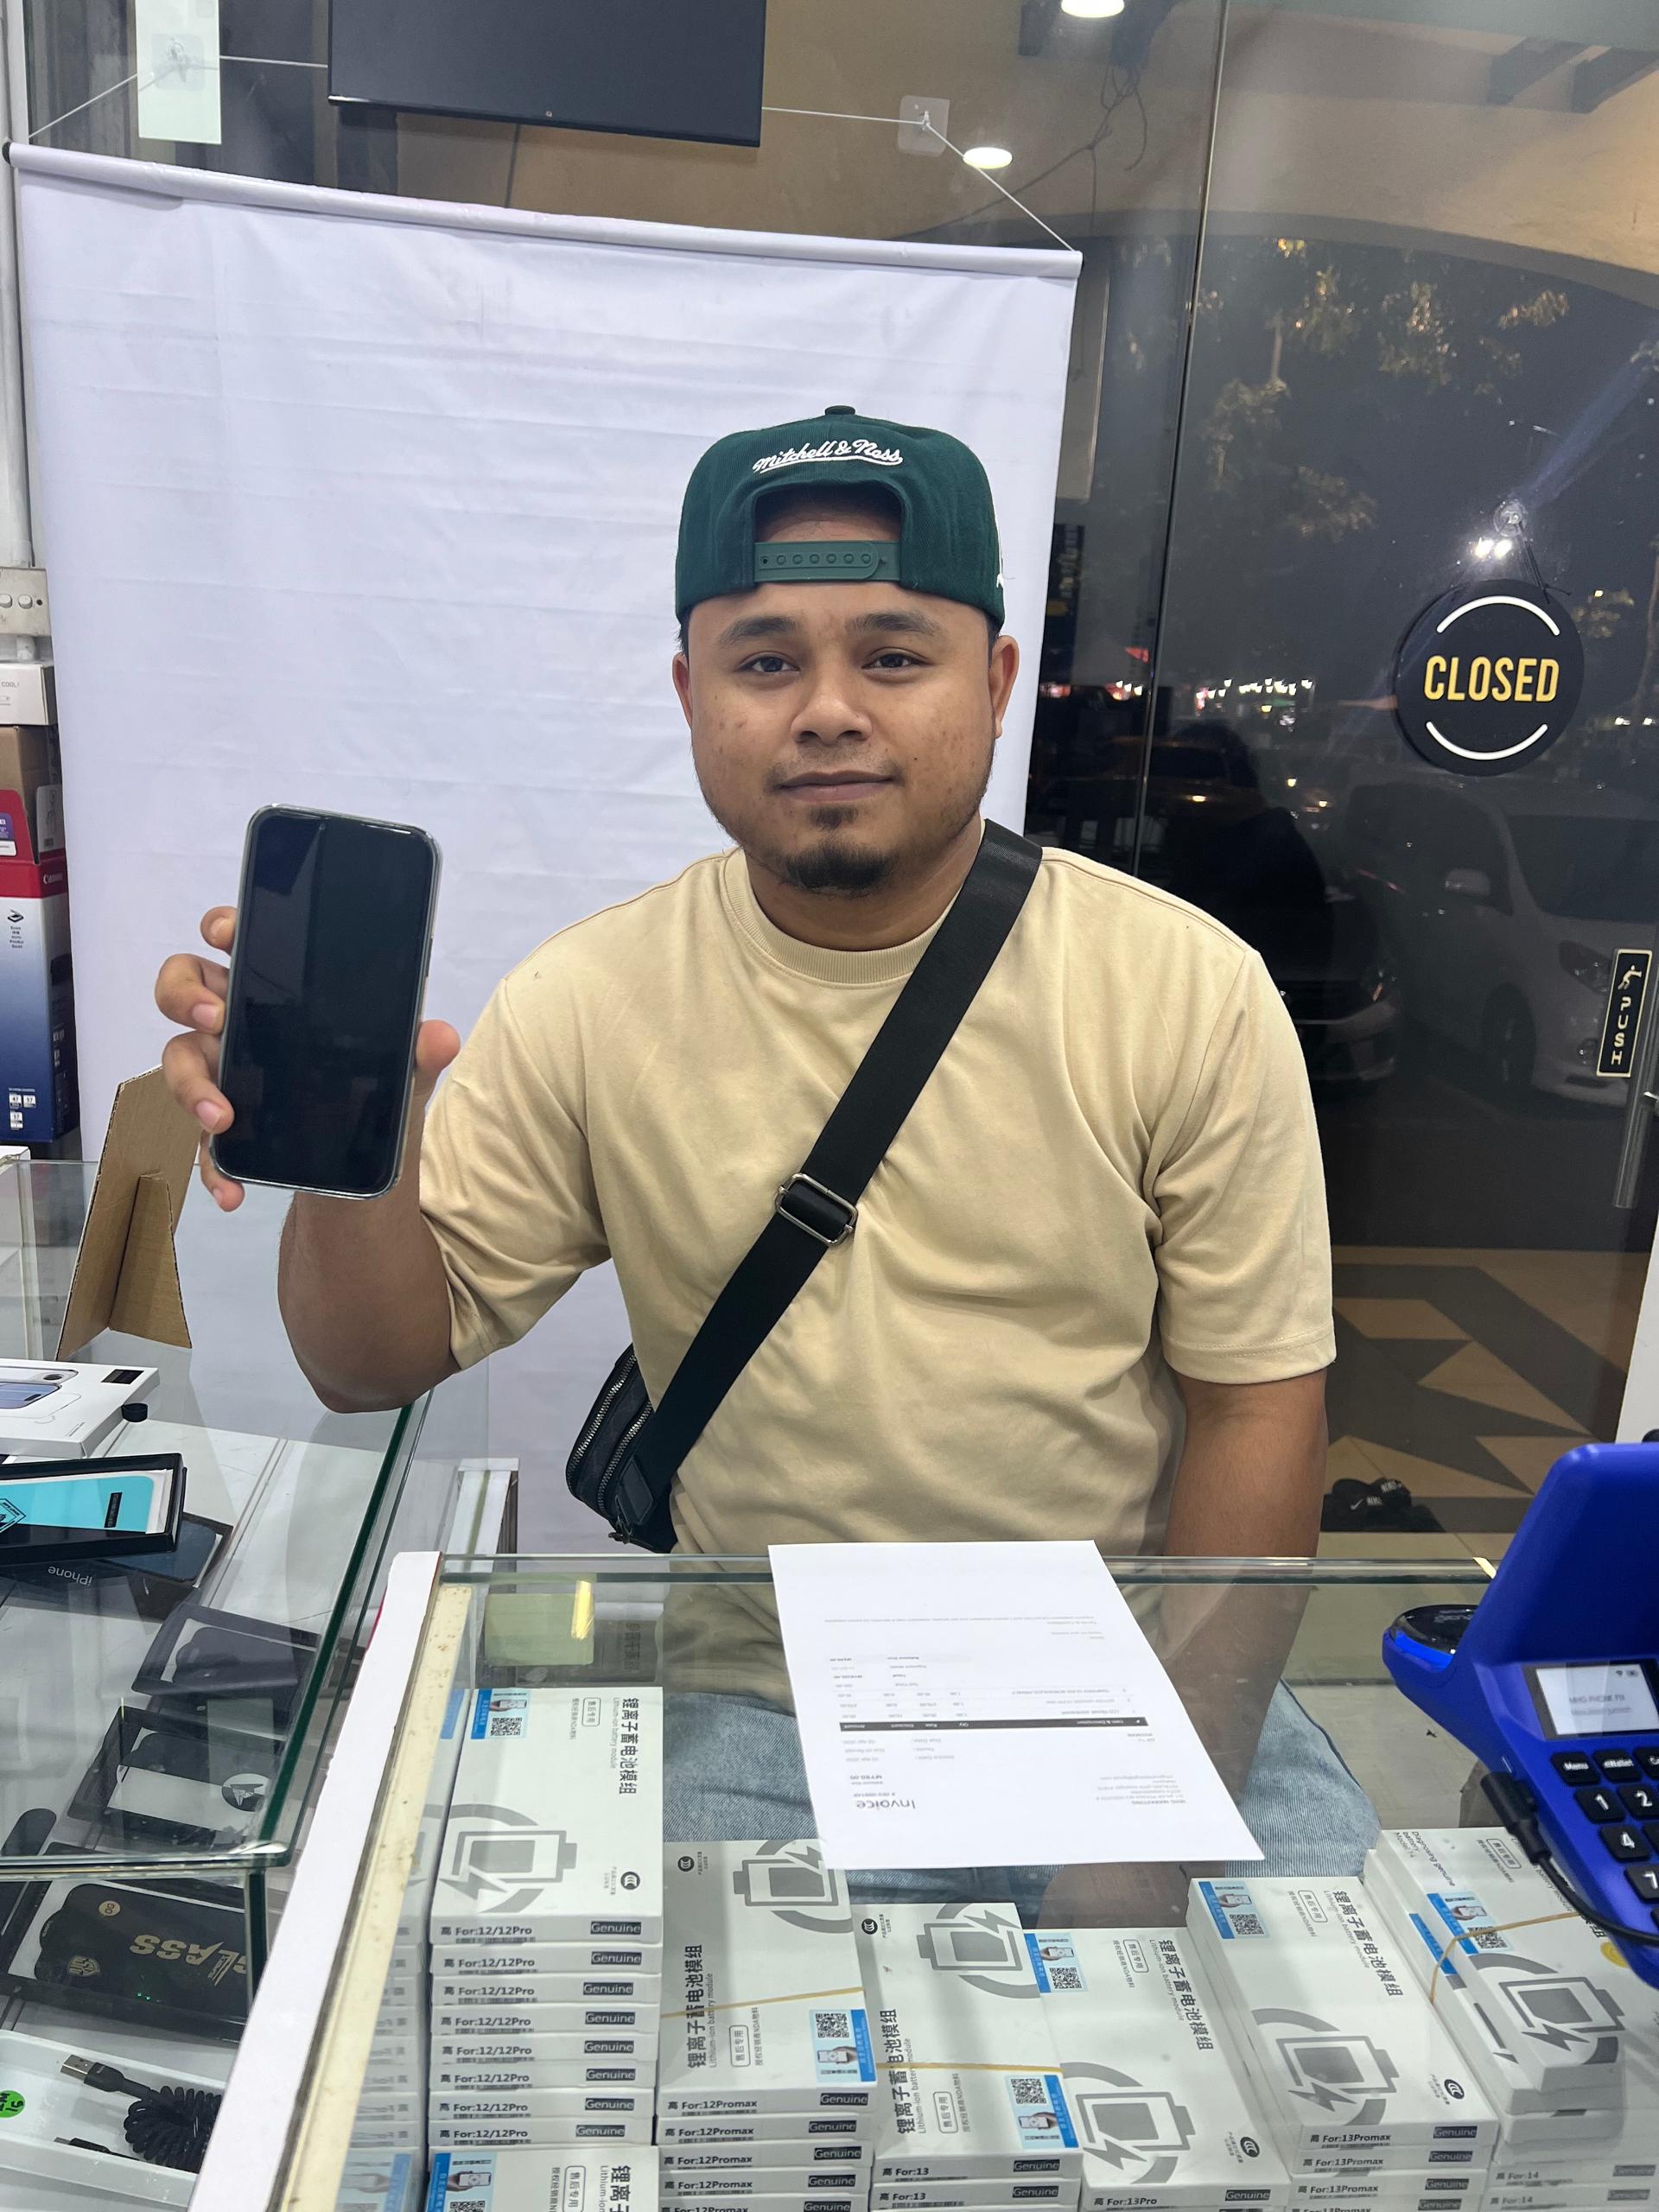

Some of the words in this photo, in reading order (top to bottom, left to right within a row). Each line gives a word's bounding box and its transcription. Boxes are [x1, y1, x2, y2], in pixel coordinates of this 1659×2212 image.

[753, 441, 837, 472] Mitchell
[835, 440, 852, 456] &
[853, 439, 904, 464] Ness
[1424, 655, 1560, 702] CLOSED
[1611, 996, 1631, 1065] PUSH
[48, 1566, 92, 1586] iPhone
[620, 1698, 639, 1794] 锂离子蓄电池模组
[1595, 1793, 1609, 1810] 1
[1635, 1790, 1652, 1807] 2
[855, 1800, 916, 1811] Invoice
[1621, 1831, 1636, 1848] 4
[1643, 1871, 1658, 1889] 7
[455, 1926, 532, 1936] For:12/12Pro
[592, 1923, 641, 1934] Genuine
[1332, 1891, 1403, 1996] 锂离子蓄电池模组
[459, 1958, 535, 1967] For:12/12Pro
[592, 1953, 641, 1964] Genuine
[459, 1986, 535, 1996] For:12/12Pro
[583, 1983, 632, 1994] Genuine
[1158, 1940, 1214, 2050] 锂离子蓄电池模组
[684, 1945, 706, 2068] 锂离子蓄电池模组
[455, 2017, 531, 2026] For:12/12Pro
[586, 2012, 635, 2024] Genuine
[456, 2046, 531, 2056] For:12/12Pro
[585, 2041, 633, 2053] Genuine
[454, 2074, 530, 2083] For:12/12Pro
[587, 2069, 635, 2081] Genuine
[586, 2098, 634, 2110] Genuine
[682, 2100, 757, 2109] For:12Promax
[821, 2094, 868, 2106] Genuine
[453, 2103, 528, 2112] For:12/12Pro
[576, 2125, 625, 2137] Genuine
[809, 2121, 856, 2133] Genuine
[1433, 2126, 1477, 2138] Genuine
[454, 2129, 528, 2138] For:12/12Pro
[1322, 2134, 1391, 2143] For:13Promax
[815, 2147, 861, 2159] Genuine
[1429, 2152, 1472, 2162] Genuine
[677, 2156, 753, 2164] For:12Promax
[1014, 2160, 1059, 2171] Genuine
[1315, 2158, 1383, 2167] For:13Promax
[895, 2167, 929, 2176] For:13
[809, 2176, 855, 2188] Genuine
[1427, 2179, 1468, 2190] Genuine
[569, 2171, 580, 2208] 售后专用
[1014, 2187, 1059, 2197] Genuine
[1310, 2185, 1378, 2194] For:13Promax
[1226, 2190, 1270, 2201] Genuine
